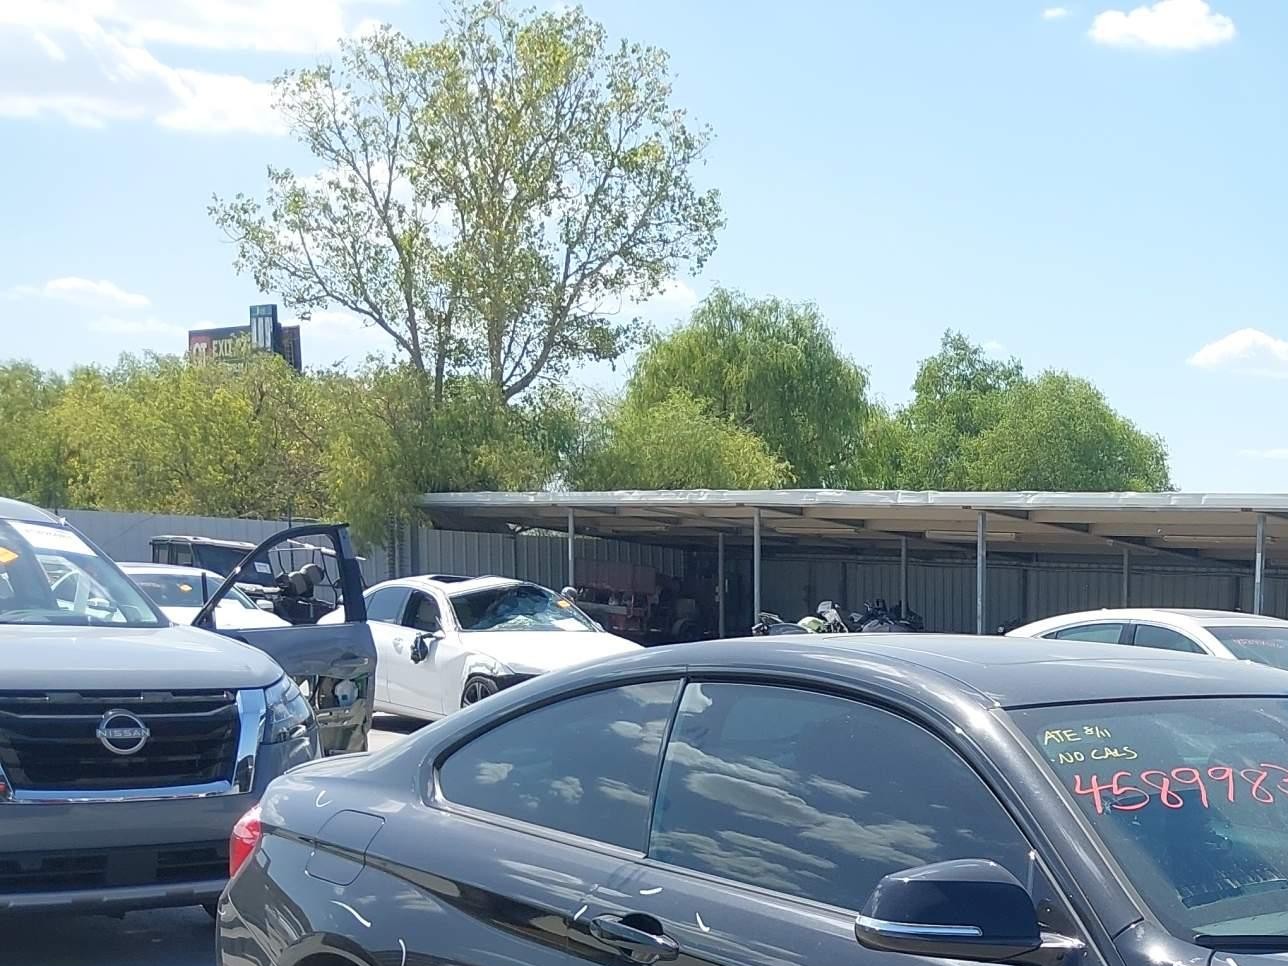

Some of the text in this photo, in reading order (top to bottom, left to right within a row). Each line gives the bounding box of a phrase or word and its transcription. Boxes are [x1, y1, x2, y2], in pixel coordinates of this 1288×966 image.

[96, 728, 150, 738] NISSAN
[1044, 729, 1082, 745] ATE
[1058, 746, 1138, 764] NO CALS
